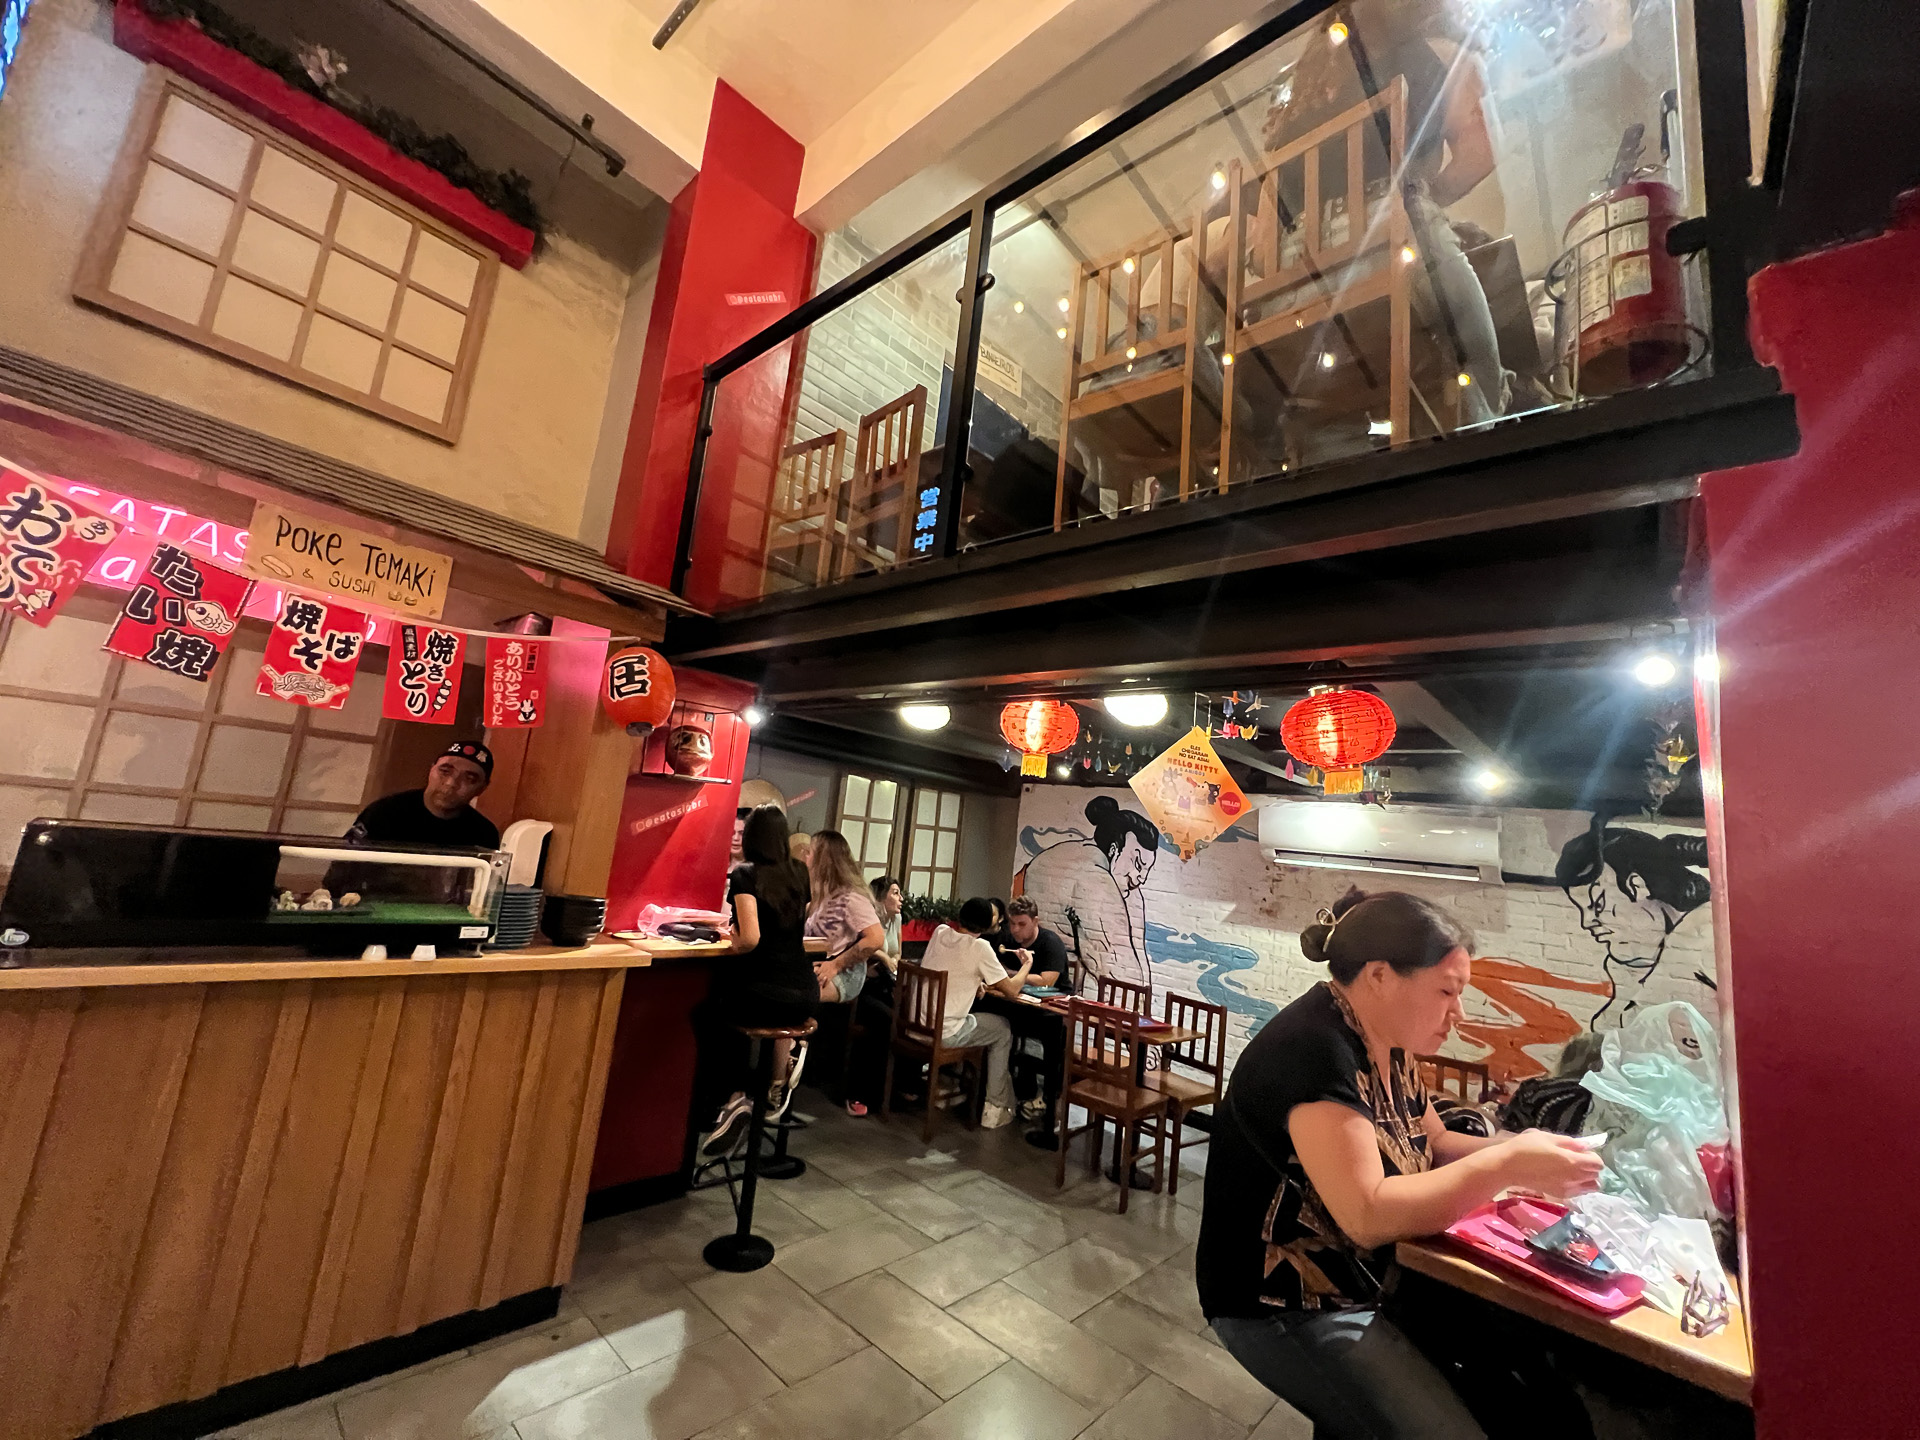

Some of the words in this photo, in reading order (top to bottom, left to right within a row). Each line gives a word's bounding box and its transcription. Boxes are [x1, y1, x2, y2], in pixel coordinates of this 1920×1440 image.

[302, 568, 314, 580] &
[328, 570, 376, 597] SUSHI
[609, 654, 649, 700] 居
[1167, 757, 1193, 768] HELLO
[1194, 763, 1219, 775] KITTY
